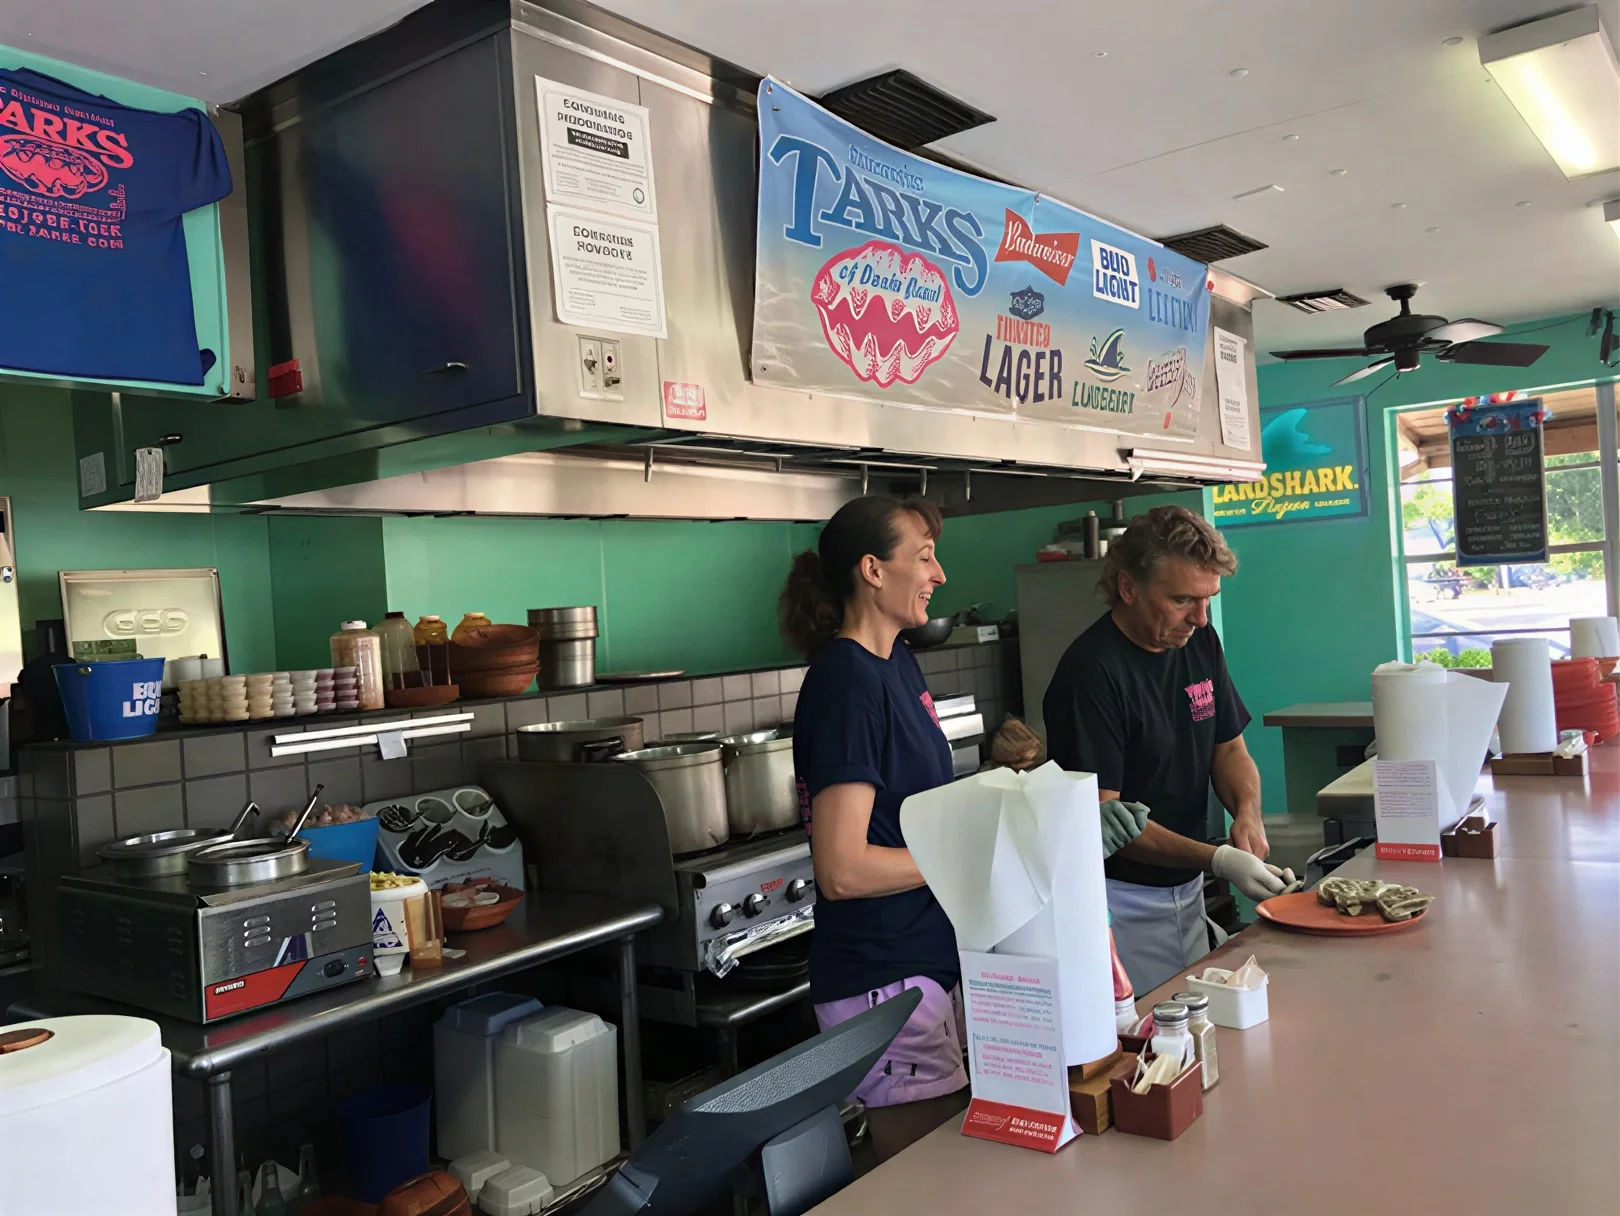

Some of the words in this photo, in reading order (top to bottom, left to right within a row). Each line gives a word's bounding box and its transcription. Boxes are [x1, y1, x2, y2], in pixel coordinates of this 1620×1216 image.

[0, 97, 134, 169] ARKS
[766, 132, 989, 297] TARKS
[979, 333, 1063, 404] LAGER
